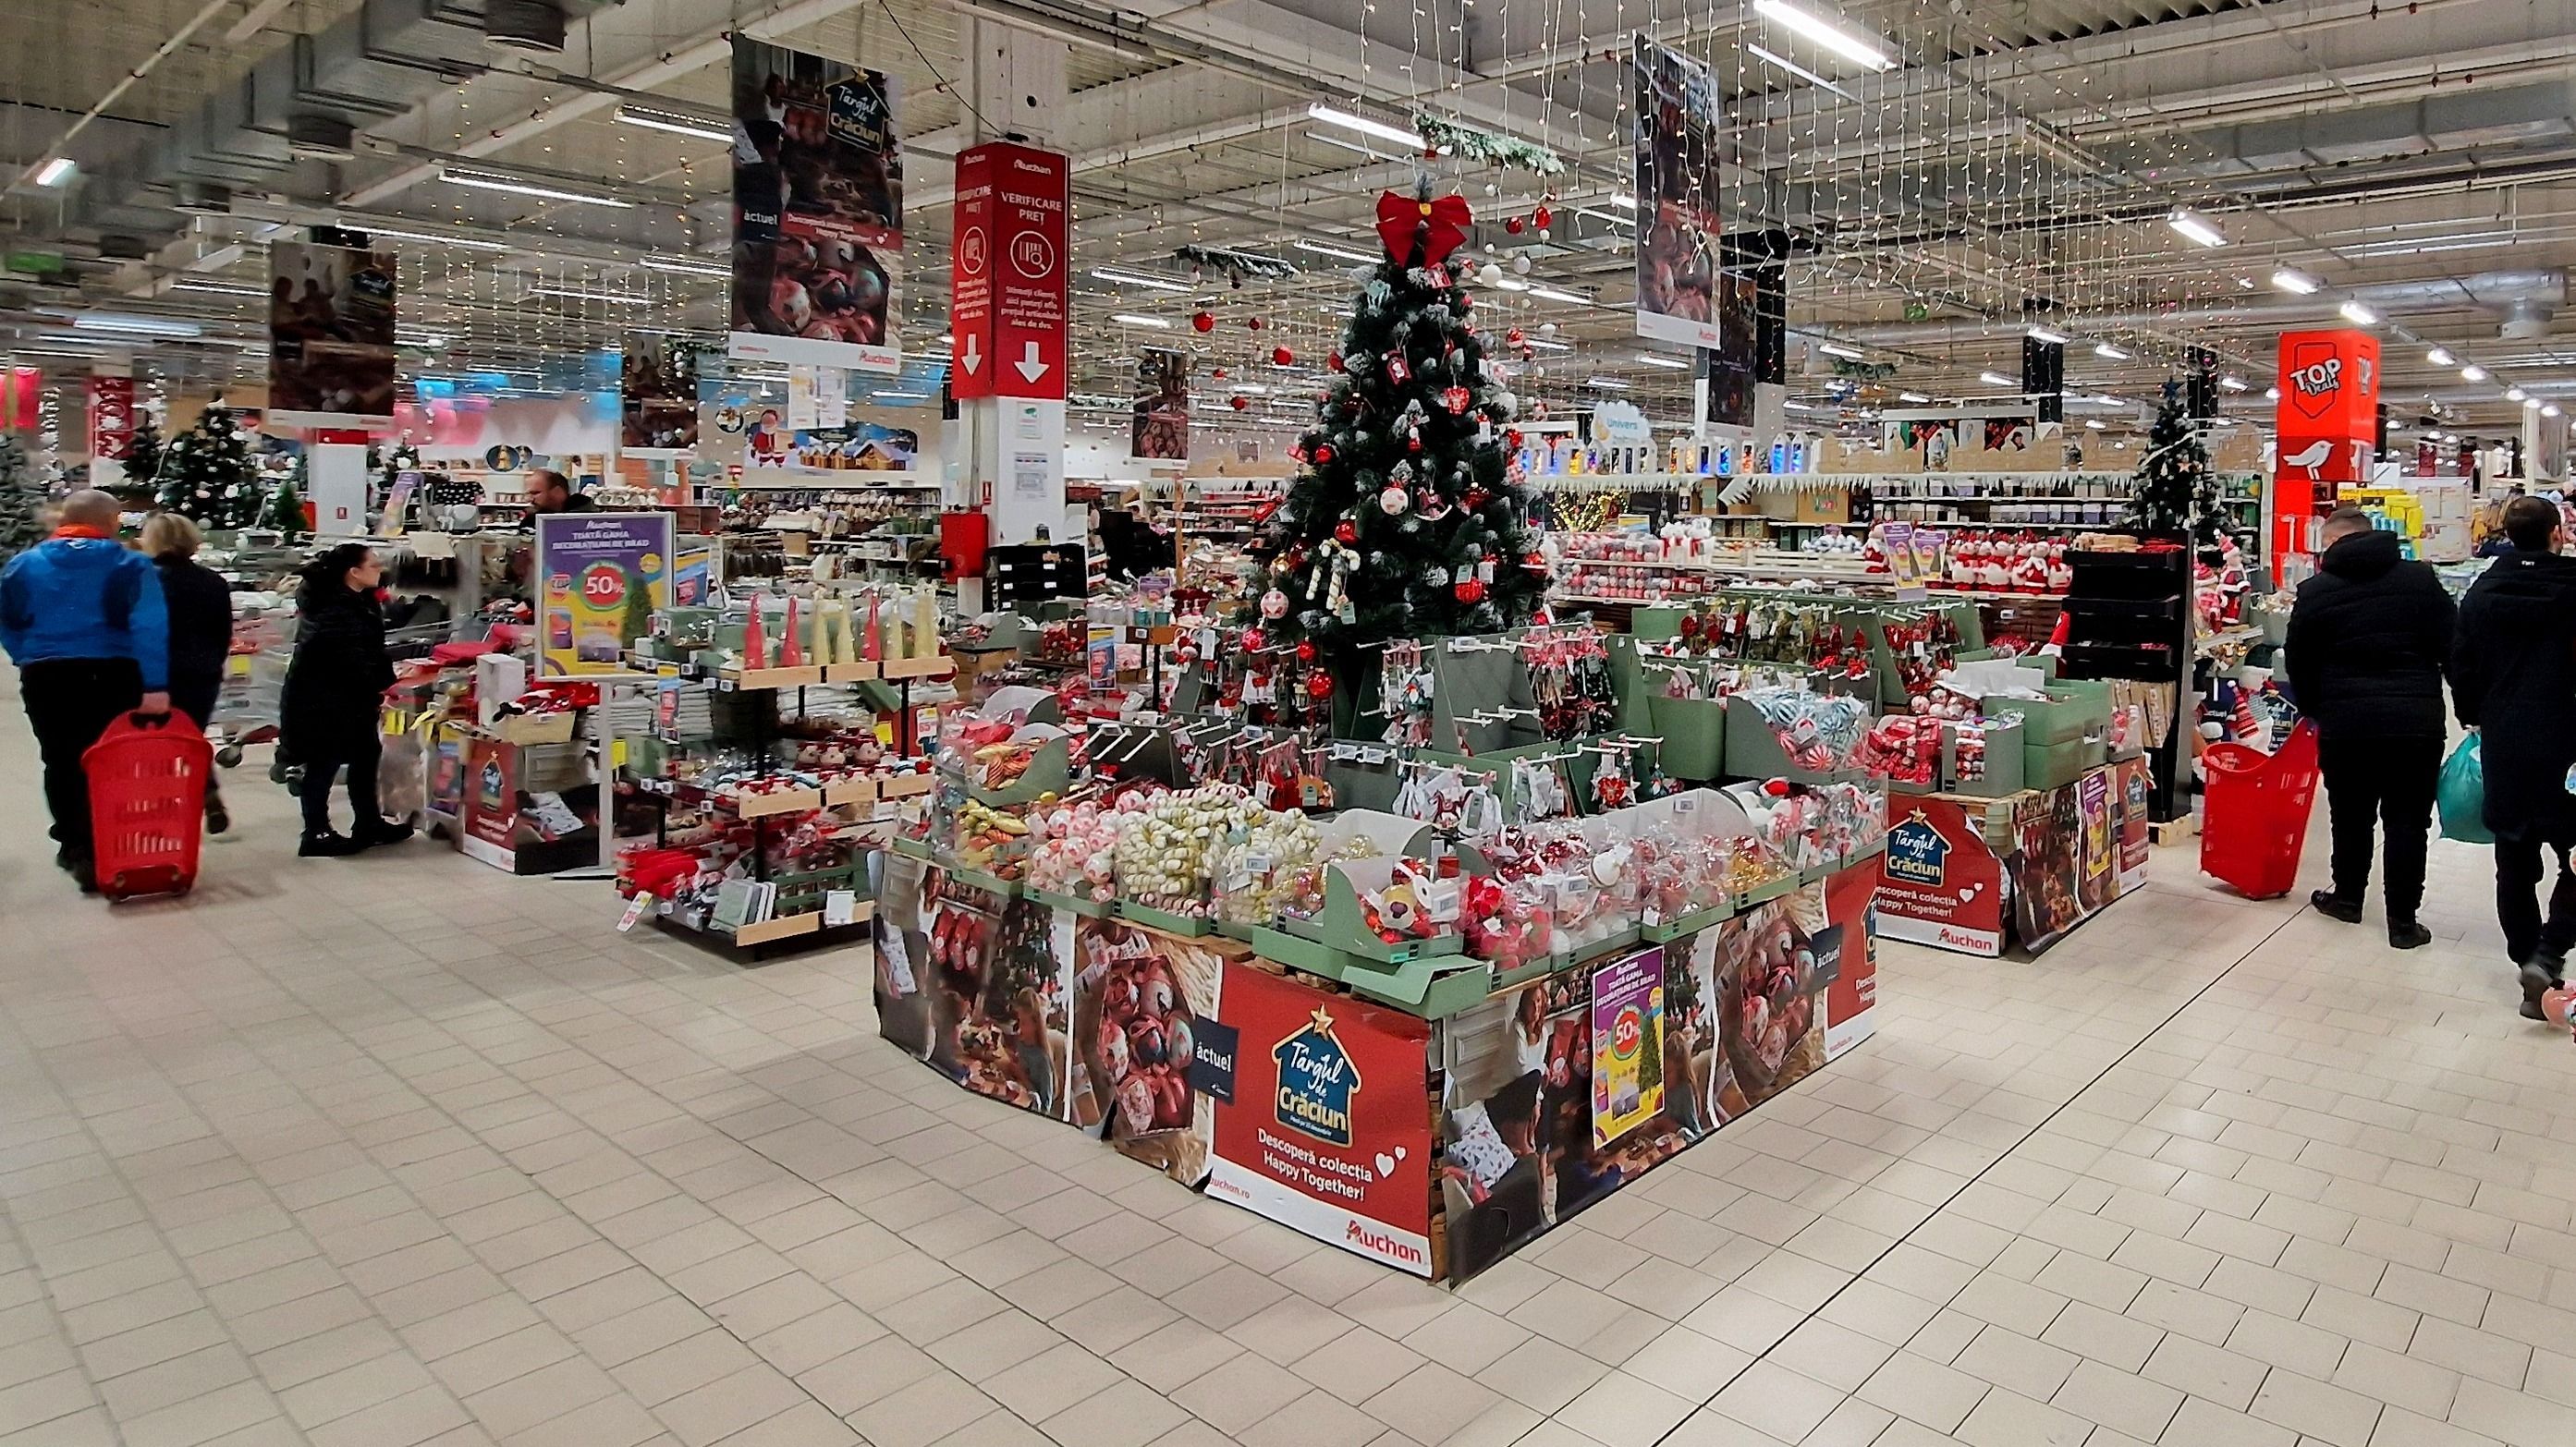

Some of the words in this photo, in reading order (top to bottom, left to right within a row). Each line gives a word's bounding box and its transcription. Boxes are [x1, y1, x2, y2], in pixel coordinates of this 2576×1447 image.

[1014, 158, 1052, 176] Auchan
[1000, 190, 1063, 212] VERIFICARE
[2289, 359, 2342, 392] TOP
[585, 576, 627, 595] 50%
[1895, 829, 1938, 857] Târgul
[1888, 855, 1941, 878] Crăciun
[1876, 884, 1918, 900] escoperă
[1918, 892, 1959, 907] colecția
[1938, 928, 1993, 952] Auchan
[1291, 1041, 1345, 1090] Târgul
[1278, 1085, 1348, 1132] Crăciun
[1257, 1127, 1316, 1165] Descoperă
[1318, 1155, 1373, 1184] colecția
[1264, 1150, 1301, 1181] Happy
[1300, 1167, 1365, 1201] Together!
[1346, 1219, 1422, 1264] Auchan
